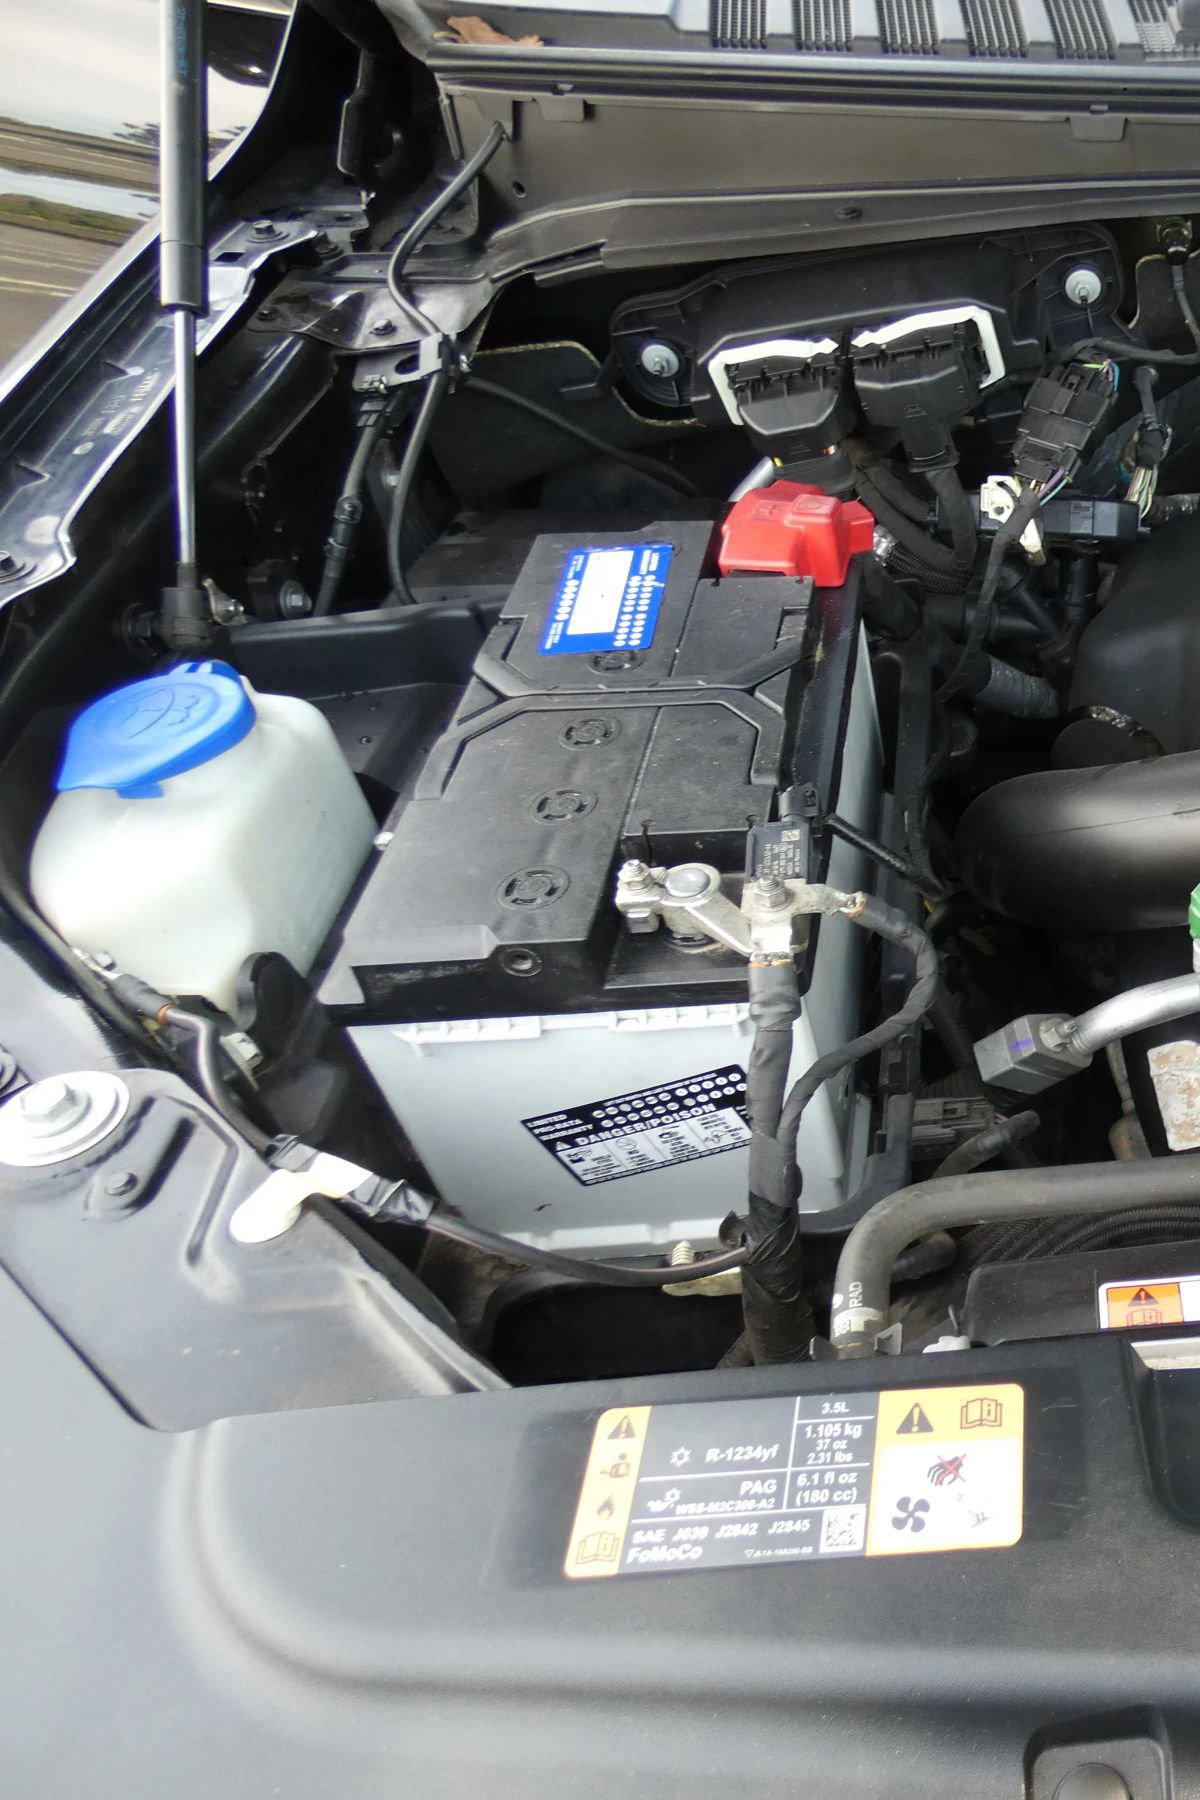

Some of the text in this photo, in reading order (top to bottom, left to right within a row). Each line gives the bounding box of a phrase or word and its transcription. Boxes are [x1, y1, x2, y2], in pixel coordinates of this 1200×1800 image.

[575, 1103, 716, 1146] DANGER/POISON
[849, 1281, 863, 1308] RAD
[821, 1401, 850, 1415] 3.5L
[804, 1422, 862, 1439] 1.105 kg
[704, 1443, 780, 1464] R-1234yf
[815, 1438, 849, 1451] 37 oz
[806, 1450, 854, 1465] 2.31 lbs
[740, 1479, 777, 1496] PAG
[823, 1471, 836, 1485] fl
[838, 1472, 859, 1484] oz
[796, 1486, 858, 1507] (180 cc)
[632, 1529, 667, 1544] SAE
[767, 1519, 811, 1536] J2845
[626, 1543, 704, 1564] FoMoCo
